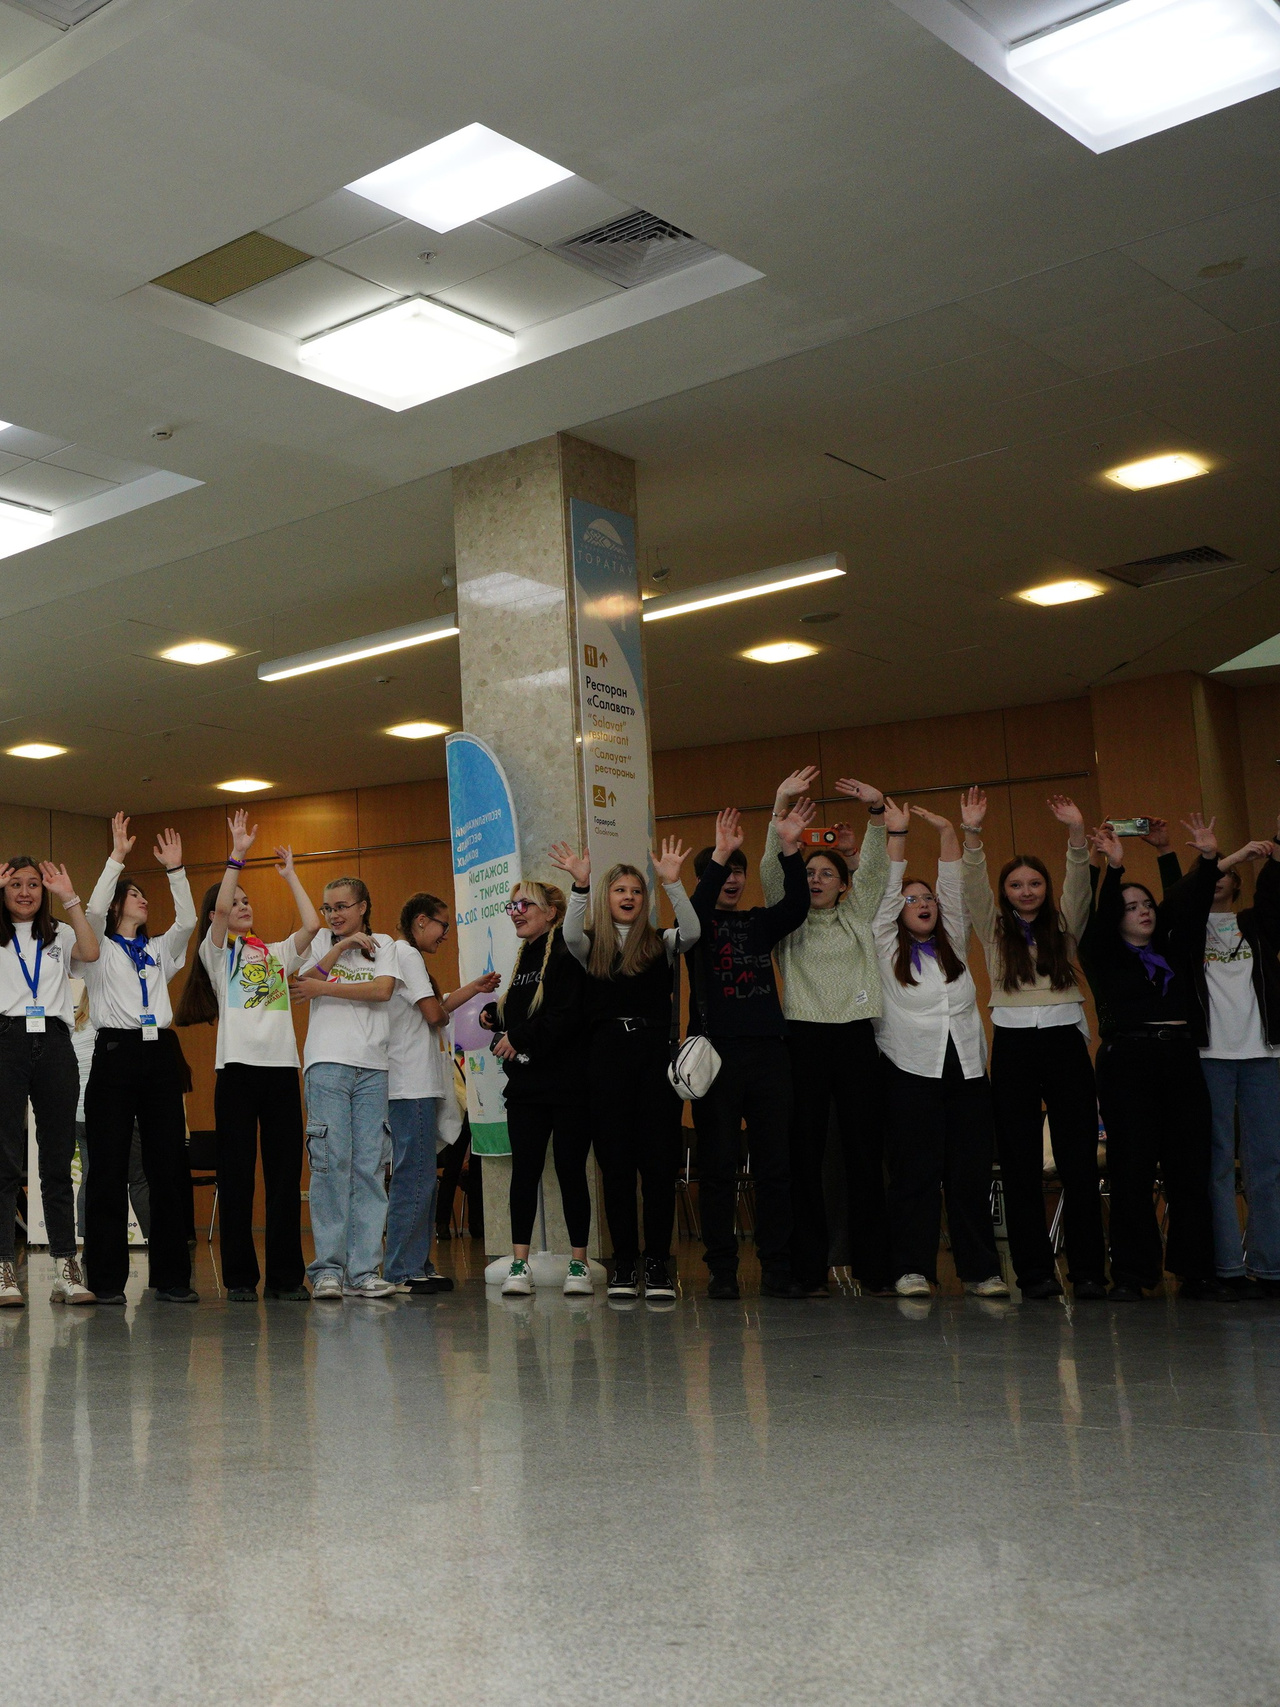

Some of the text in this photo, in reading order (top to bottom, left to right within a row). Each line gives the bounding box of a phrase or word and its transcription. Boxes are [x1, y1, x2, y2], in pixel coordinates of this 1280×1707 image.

[586, 676, 628, 698] Ресторан
[587, 695, 636, 716] «Салават»
[589, 729, 629, 746] restaurant
[595, 763, 636, 779] рестораны
[594, 816, 616, 827] Гардероб
[594, 827, 619, 838] Cloakroom
